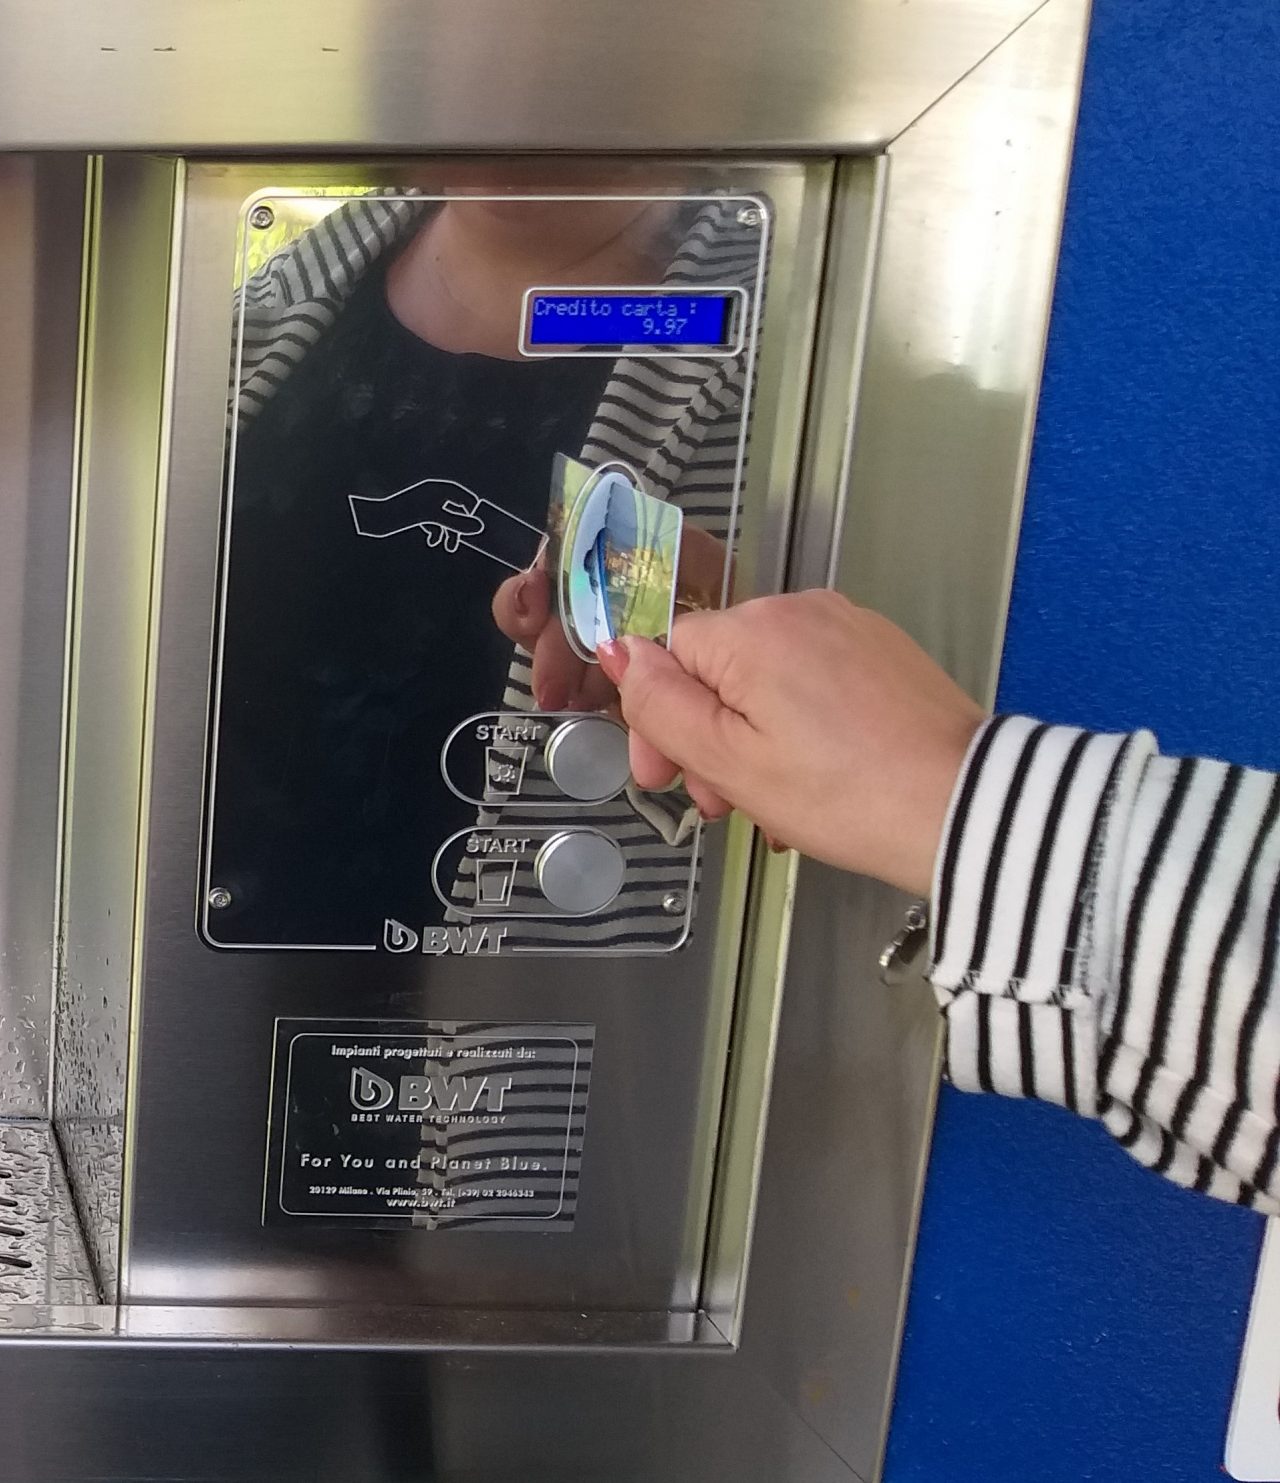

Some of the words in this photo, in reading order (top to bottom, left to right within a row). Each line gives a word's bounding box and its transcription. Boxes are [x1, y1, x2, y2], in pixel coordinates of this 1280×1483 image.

[533, 299, 612, 317] Credito
[621, 301, 678, 317] carta
[642, 318, 688, 336] 9.97
[475, 724, 542, 741] START
[465, 838, 530, 853] START
[421, 926, 508, 955] BWT
[331, 1044, 381, 1059] Impianti
[383, 1046, 442, 1060] progettati
[446, 1049, 454, 1058] e
[456, 1046, 513, 1059] realizzati
[516, 1046, 537, 1059] da:
[398, 1075, 513, 1113] BWT
[350, 1113, 381, 1123] BEST
[385, 1114, 424, 1124] WATER
[429, 1114, 507, 1125] TECHNOLOGY
[300, 1153, 332, 1168] For
[340, 1153, 375, 1169] You
[384, 1154, 421, 1170] and
[430, 1155, 492, 1170] Planet
[500, 1155, 549, 1171] Blue.
[338, 1186, 368, 1196] Milano
[375, 1187, 391, 1196] Via
